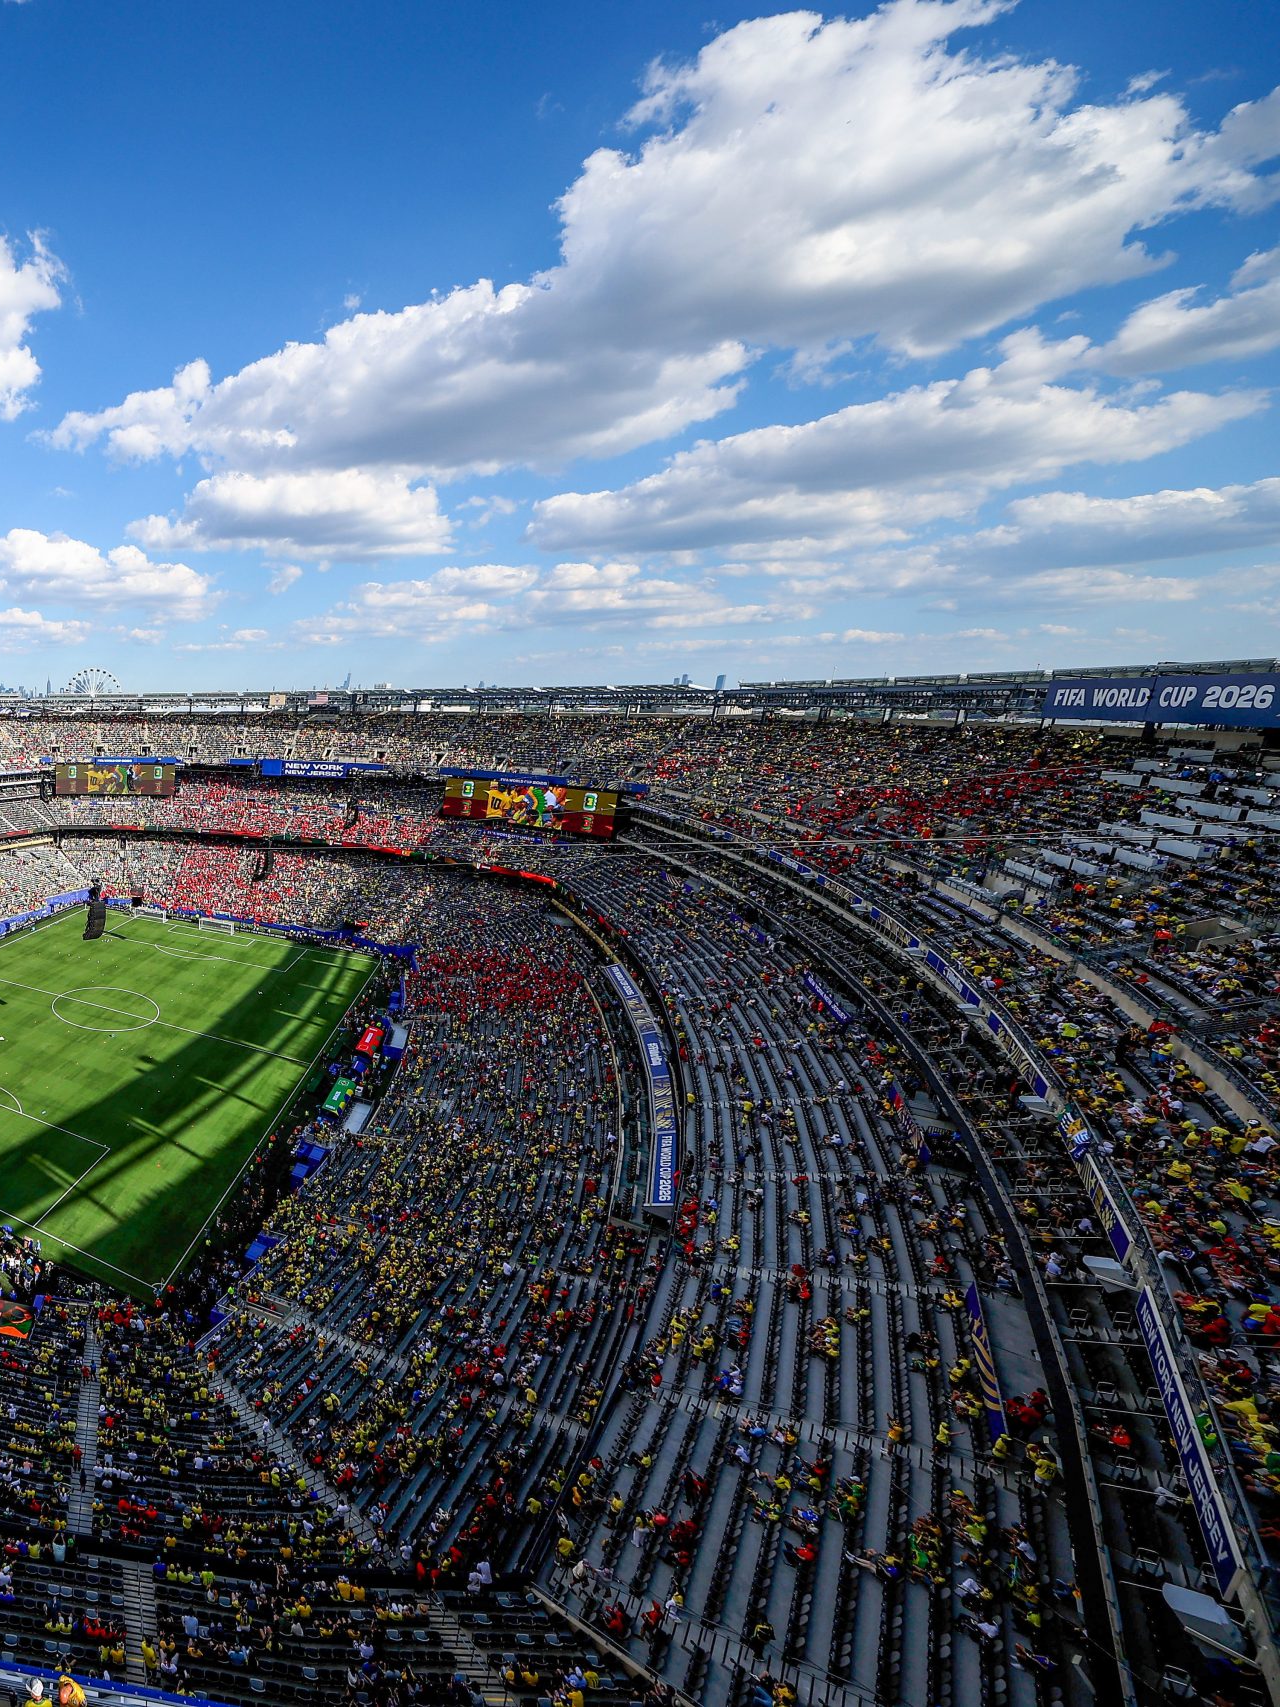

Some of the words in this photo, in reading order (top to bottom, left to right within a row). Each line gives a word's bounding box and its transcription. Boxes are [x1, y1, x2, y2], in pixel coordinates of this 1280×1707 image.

[1053, 688, 1086, 707] FIFA
[1092, 687, 1150, 708] WORLD
[1159, 686, 1198, 708] CUP
[1201, 684, 1276, 709] 2026
[285, 762, 311, 770] NEW
[312, 763, 344, 771] YORK
[490, 796, 502, 810] 10
[661, 1136, 672, 1148] FIFA
[660, 1147, 672, 1166] WORLD
[660, 1168, 672, 1180] CUP
[658, 1180, 672, 1201] 2026
[1140, 1302, 1158, 1350] NEW
[1154, 1342, 1175, 1404] YORK
[1171, 1398, 1192, 1455] NEW
[1188, 1458, 1229, 1562] JERSEY
